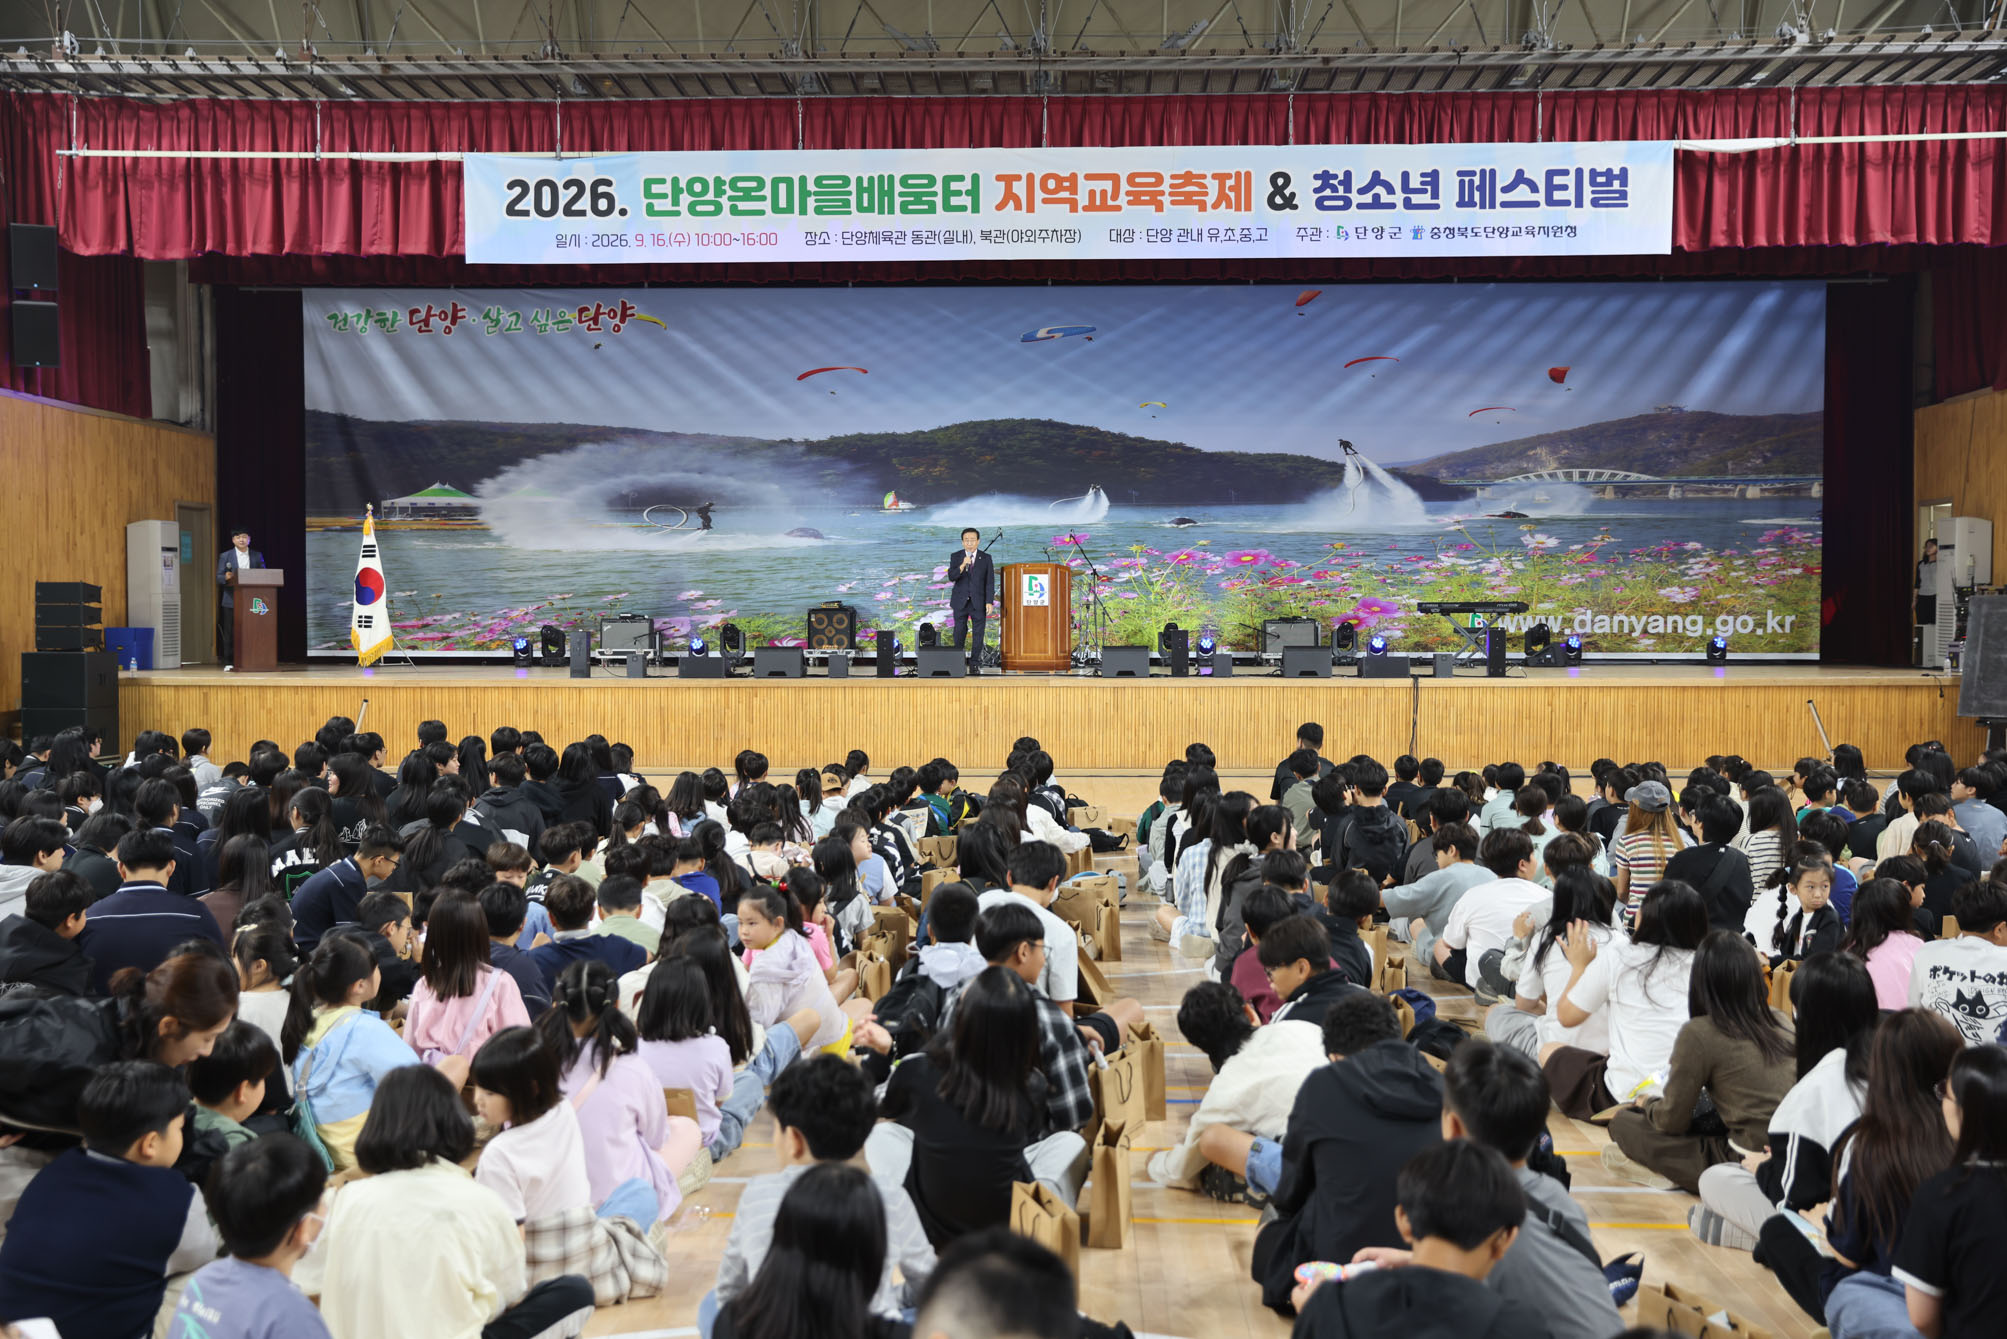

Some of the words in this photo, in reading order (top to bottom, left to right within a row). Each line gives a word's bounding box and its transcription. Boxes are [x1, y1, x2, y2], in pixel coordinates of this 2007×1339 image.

[505, 178, 629, 218] 2026.
[642, 173, 982, 217] 단양온마을배움터
[994, 171, 1253, 214] 지역교육축제
[1266, 171, 1299, 212] &
[1312, 168, 1441, 212] 청소년
[1455, 166, 1630, 210] 페스티벌
[555, 233, 581, 249] 일시
[591, 233, 631, 248] 2026.
[634, 233, 647, 248] 9.
[695, 232, 778, 247] 10:00~16:00
[804, 231, 833, 247] 장소
[841, 230, 909, 246] 단양체육관
[911, 229, 976, 246] 동관(실내),
[979, 228, 1082, 245] 북관(야외주차장)
[1108, 228, 1136, 244] 대상
[1145, 228, 1173, 243] 단양
[1176, 227, 1203, 243] 관내
[1295, 227, 1323, 242] 주관
[1429, 224, 1578, 240] 충청북도단양교육지원청
[326, 308, 402, 334] 건강한
[408, 302, 467, 335] 단양
[482, 306, 523, 335] 살고
[530, 308, 573, 334] 싶은
[577, 299, 636, 334] 단양
[1498, 609, 1797, 637] www.danyang.go.kr
